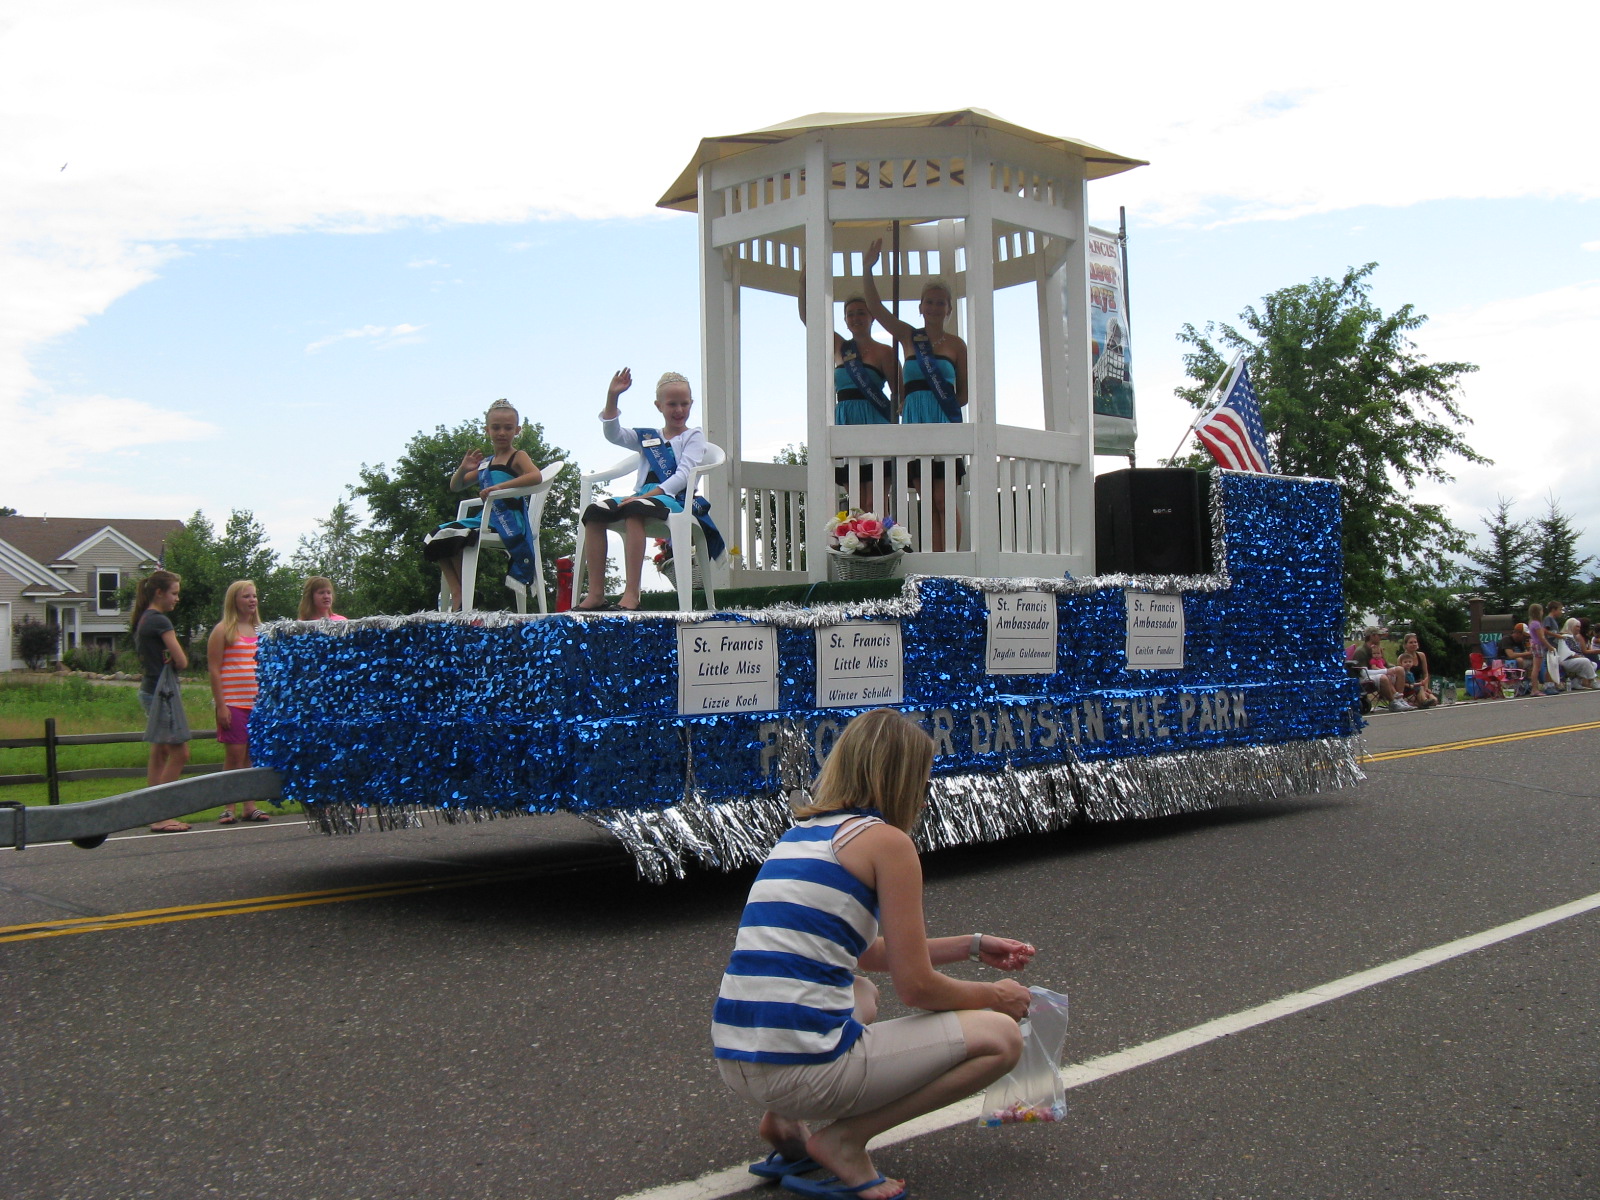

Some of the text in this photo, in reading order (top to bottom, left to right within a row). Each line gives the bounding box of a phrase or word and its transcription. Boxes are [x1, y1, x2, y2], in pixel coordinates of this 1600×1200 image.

[997, 597, 1047, 612] St. Francis
[1134, 599, 1175, 613] St. Francis
[996, 616, 1050, 630] Ambassador
[1133, 616, 1178, 629] Ambassador
[693, 636, 764, 653] St. Francis
[829, 632, 891, 649] St. Francis
[1479, 633, 1503, 643] 22174
[992, 647, 1016, 660] Jaydin
[698, 660, 761, 677] Little Miss
[834, 656, 888, 671] Little Miss
[702, 694, 758, 709] Lizzie Koch
[828, 687, 892, 701] Winter Schuldt
[970, 703, 1059, 754] DAYS
[1071, 699, 1105, 745] IN
[1112, 695, 1170, 739] THE
[1178, 690, 1248, 733] PARK
